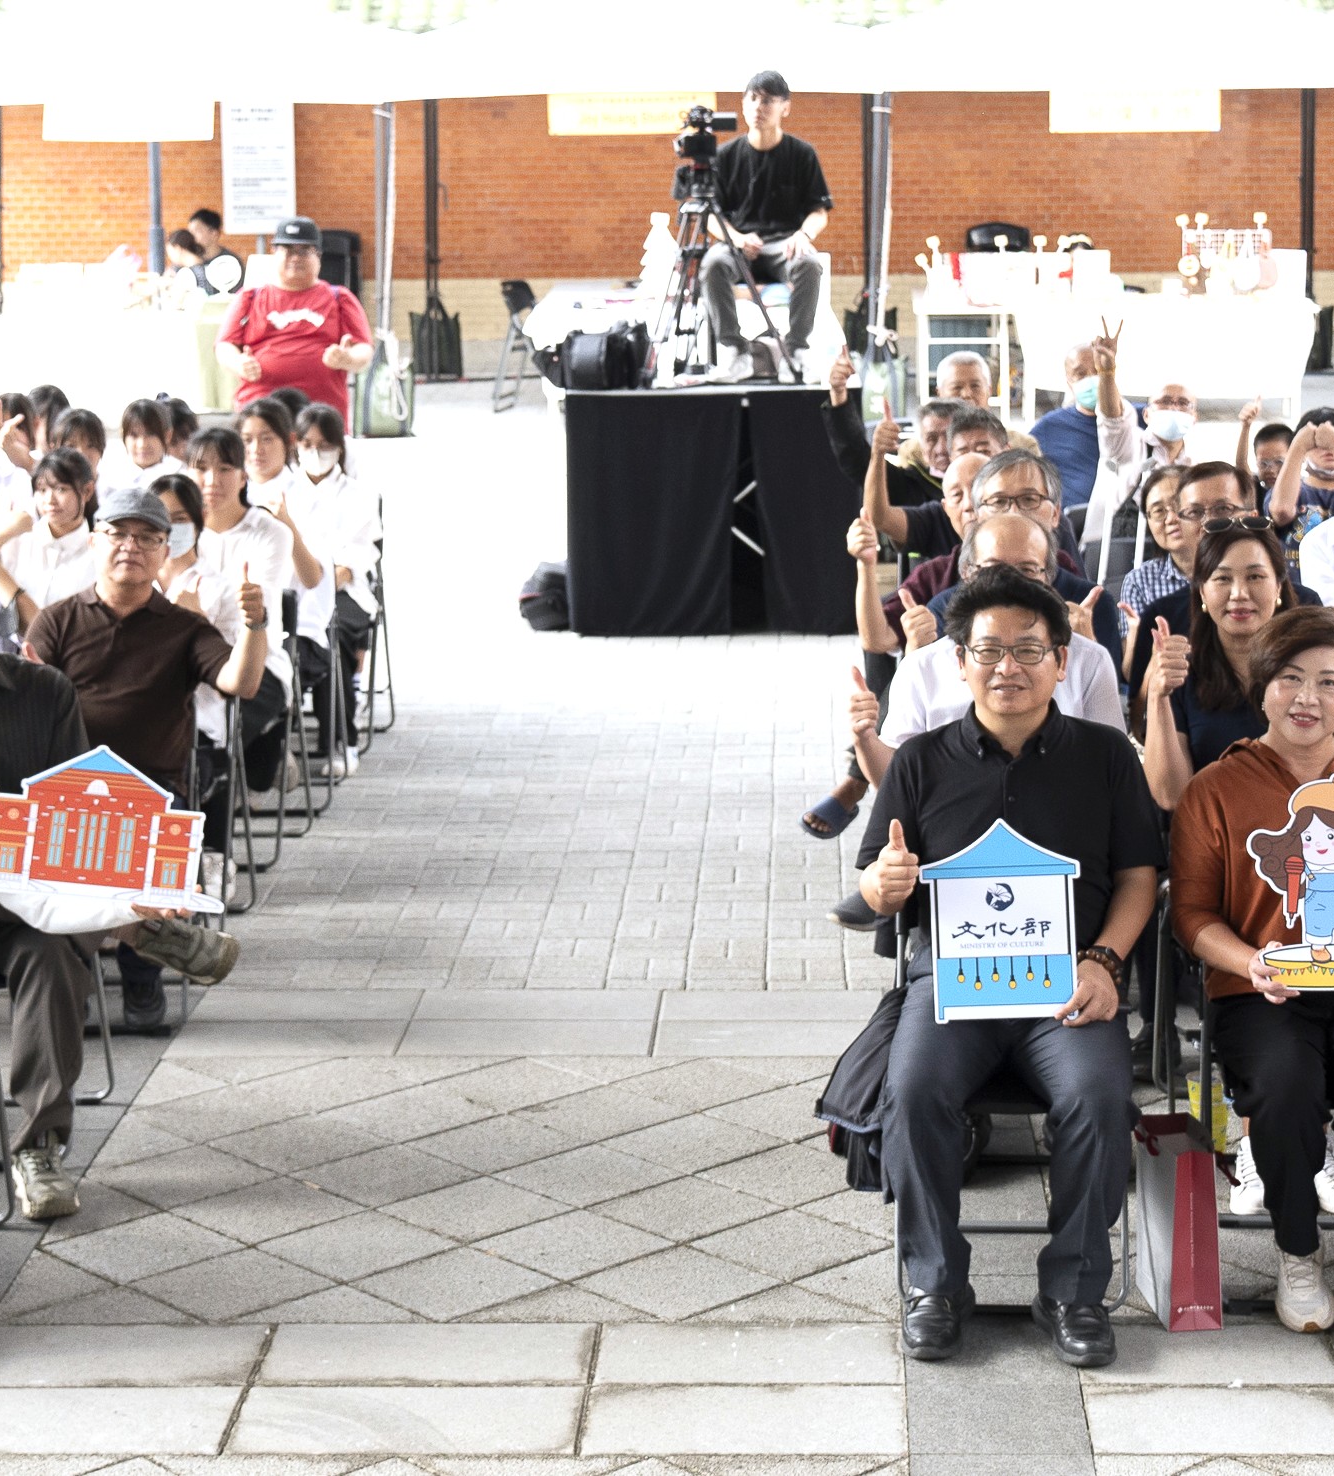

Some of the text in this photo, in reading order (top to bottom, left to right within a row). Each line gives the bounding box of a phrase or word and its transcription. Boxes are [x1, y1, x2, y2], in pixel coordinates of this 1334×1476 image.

[952, 918, 1051, 939] 文化部
[960, 941, 996, 949] MINISTRY
[1009, 940, 1044, 948] CULTURE
